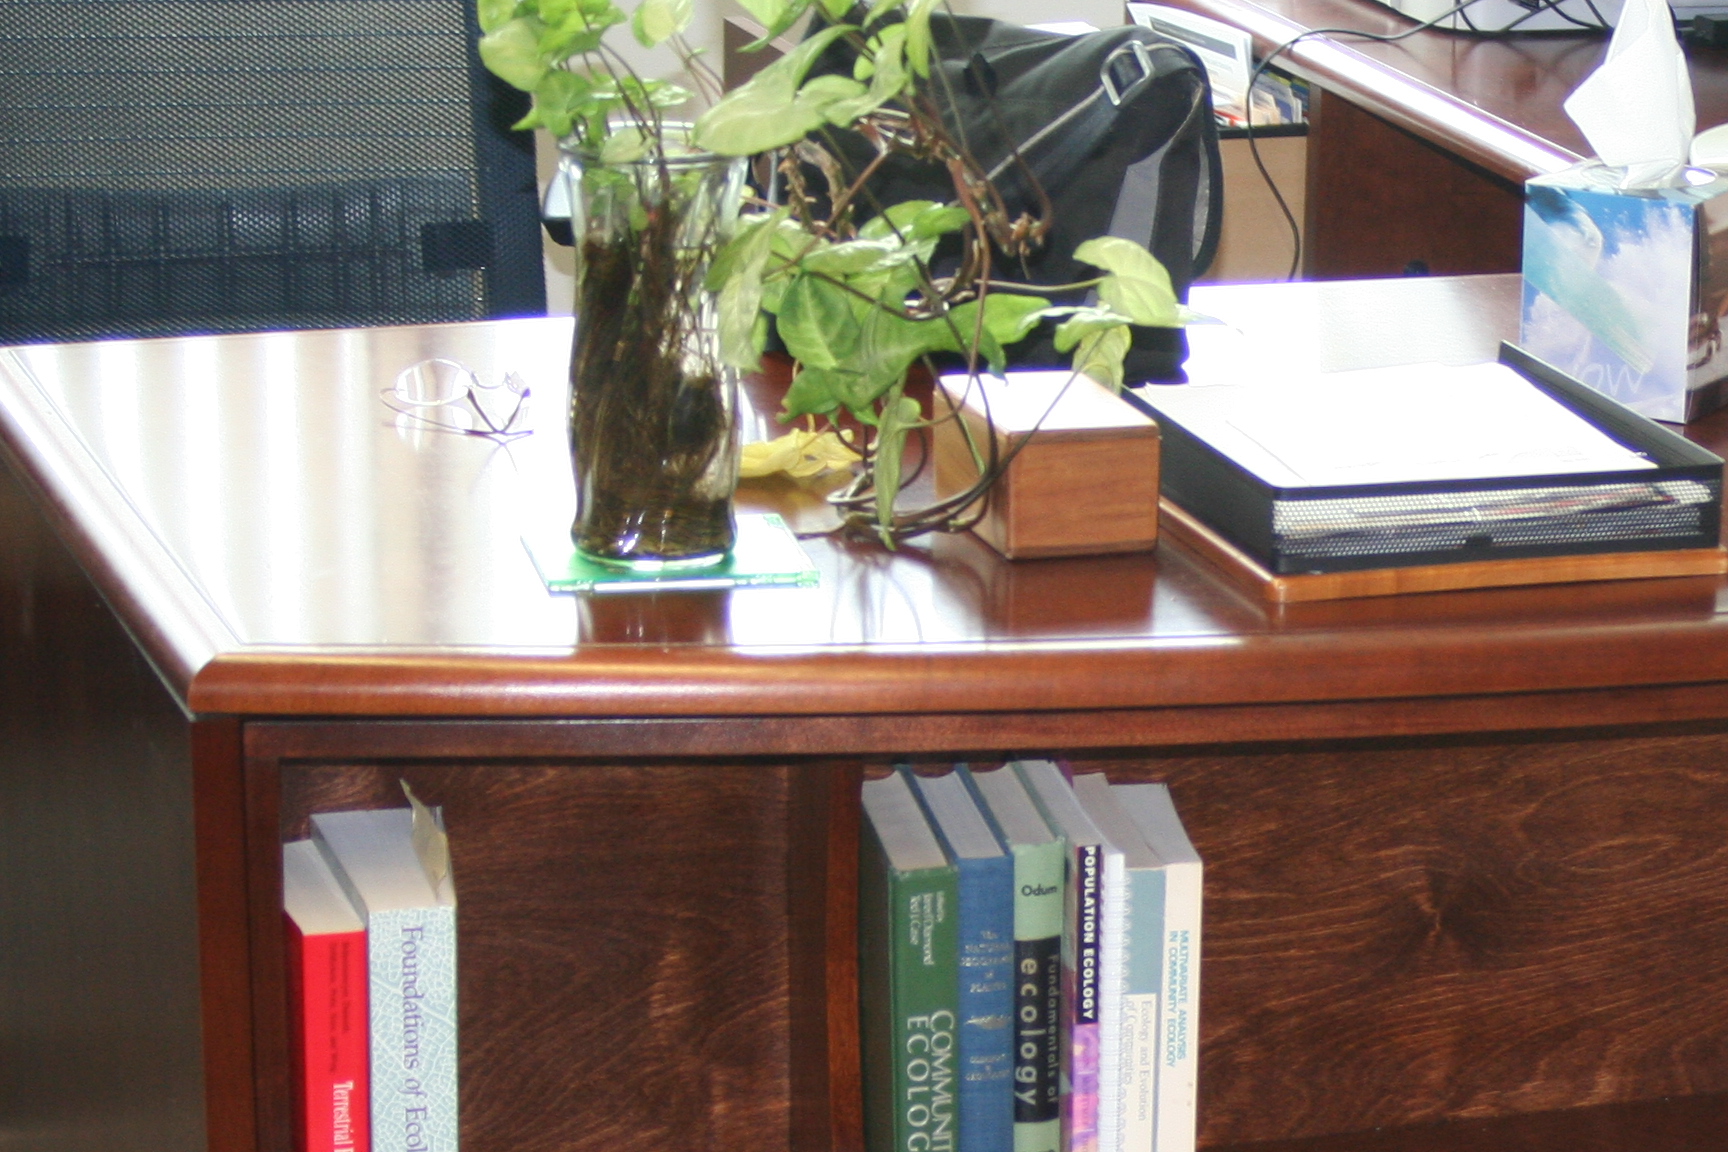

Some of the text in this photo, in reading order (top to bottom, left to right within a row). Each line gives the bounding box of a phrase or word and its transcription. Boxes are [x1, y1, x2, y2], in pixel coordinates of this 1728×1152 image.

[1020, 884, 1058, 898] Odum
[1083, 846, 1098, 943] POPULATION
[401, 925, 425, 1070] Foundations
[1014, 957, 1047, 1107] ecology
[1047, 952, 1060, 1078] Fundamentals
[1081, 948, 1095, 1019] ECOLOGY
[1165, 931, 1179, 1068] IN COMMUNITY ECOLOGY
[1176, 930, 1191, 1060] MULTIVARIATE ANALYSIS
[333, 1080, 355, 1145] Terrestrial
[397, 1077, 428, 1099] of
[1138, 1000, 1153, 1121] Ecology and Evolution
